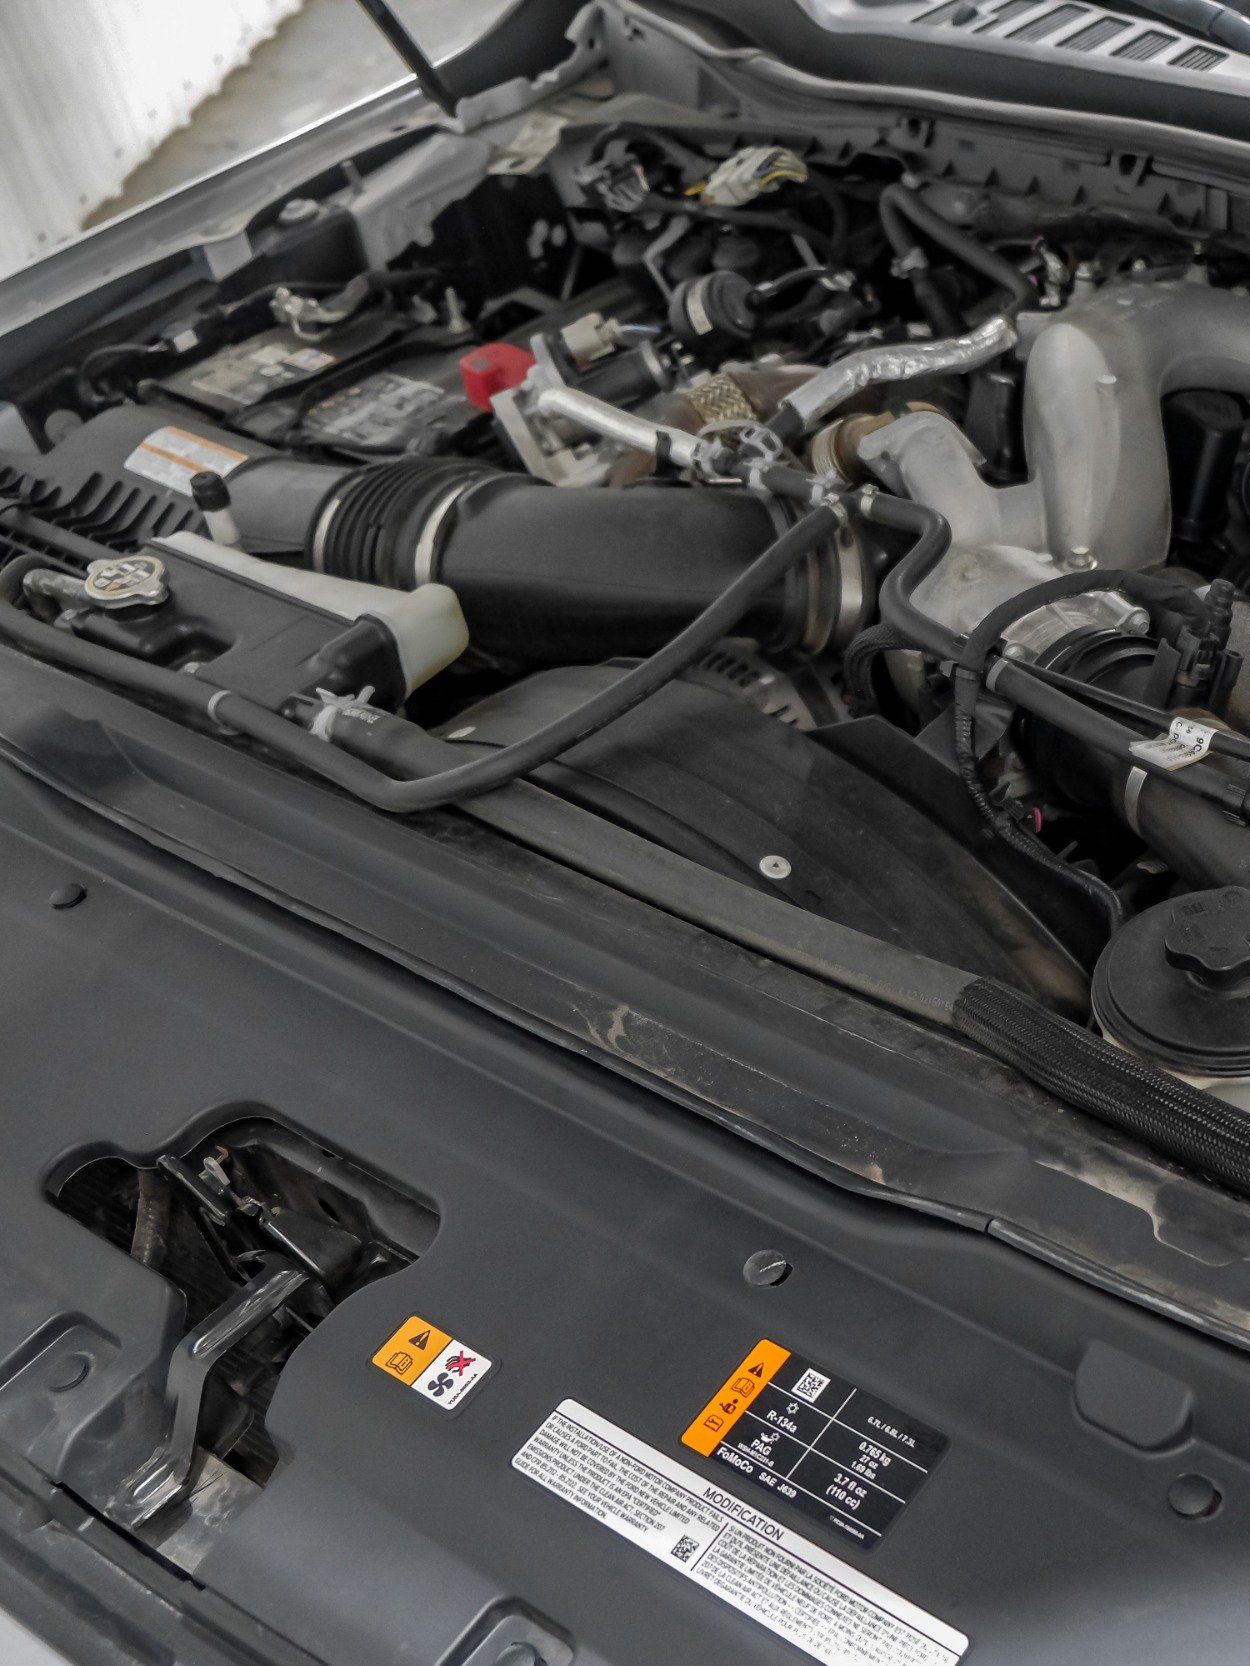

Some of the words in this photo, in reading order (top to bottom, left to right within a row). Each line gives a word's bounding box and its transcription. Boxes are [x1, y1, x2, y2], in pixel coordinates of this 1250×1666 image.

[765, 1409, 799, 1433] R-134a
[532, 1436, 560, 1456] WARRANTY
[558, 1451, 578, 1467] UNLESS
[576, 1463, 588, 1472] THE
[586, 1468, 610, 1486] PRODUCT
[613, 1485, 623, 1494] AN
[620, 1489, 633, 1500] EPA
[556, 1418, 567, 1427] THE
[608, 1449, 617, 1457] OF
[619, 1456, 646, 1475] NON-FORD
[644, 1471, 663, 1485] MOTOR
[661, 1481, 687, 1500] COMPANY
[685, 1496, 709, 1513] PRODUCT
[707, 1510, 724, 1522] FAILS
[749, 1438, 773, 1456] PAG
[849, 1460, 866, 1473] 1.69
[863, 1468, 877, 1480] lbs
[857, 1440, 883, 1459] 0.765
[877, 1452, 893, 1467] kg
[859, 1454, 870, 1463] 27
[867, 1460, 879, 1470] oz
[514, 1457, 530, 1469] GUIDE
[527, 1465, 540, 1476] FOR
[537, 1472, 548, 1481] ALL
[546, 1477, 575, 1497] WARRANTY
[520, 1450, 533, 1460] AND
[530, 1456, 542, 1466] CFR
[577, 1485, 589, 1495] SEE
[587, 1491, 602, 1503] YOUR
[600, 1499, 621, 1515] VEHICLE
[619, 1511, 649, 1532] WARRANTY
[526, 1443, 553, 1462] EMISSIONS
[550, 1458, 574, 1475] PRODUCT
[572, 1471, 590, 1485] UNDER
[589, 1481, 600, 1491] THE
[598, 1487, 616, 1501] CLEAN
[613, 1497, 624, 1506] AIR
[633, 1509, 656, 1525] SECTION
[538, 1428, 560, 1444] DAMAGE
[558, 1440, 571, 1451] WILL
[569, 1447, 582, 1458] NOT
[579, 1453, 588, 1461] BE
[586, 1457, 610, 1475] COVERED
[607, 1470, 616, 1479] BY
[615, 1475, 626, 1485] THE
[624, 1481, 639, 1493] FORD
[637, 1489, 650, 1500] NEW
[649, 1496, 670, 1512] VEHICLE
[668, 1508, 690, 1524] LIMITED
[544, 1421, 554, 1430] OR
[551, 1425, 572, 1440] CAUSES
[573, 1439, 588, 1451] FORD
[586, 1447, 601, 1459] PART
[599, 1455, 608, 1463] TO
[618, 1466, 629, 1476] THE
[627, 1472, 642, 1483] COST
[640, 1480, 649, 1488] OF
[647, 1484, 659, 1494] THE
[657, 1490, 676, 1504] REPAIR
[674, 1500, 687, 1511] AND
[685, 1507, 697, 1517] ANY
[696, 1514, 720, 1531] RELATED
[715, 1446, 756, 1474] FoMoCo
[757, 1471, 777, 1486] SAE
[776, 1482, 798, 1498] J639
[833, 1472, 850, 1486] 3.7
[853, 1485, 868, 1498] oz
[702, 1486, 785, 1541] MODIFICATION
[824, 1483, 848, 1502] (110
[842, 1493, 862, 1510] cc)
